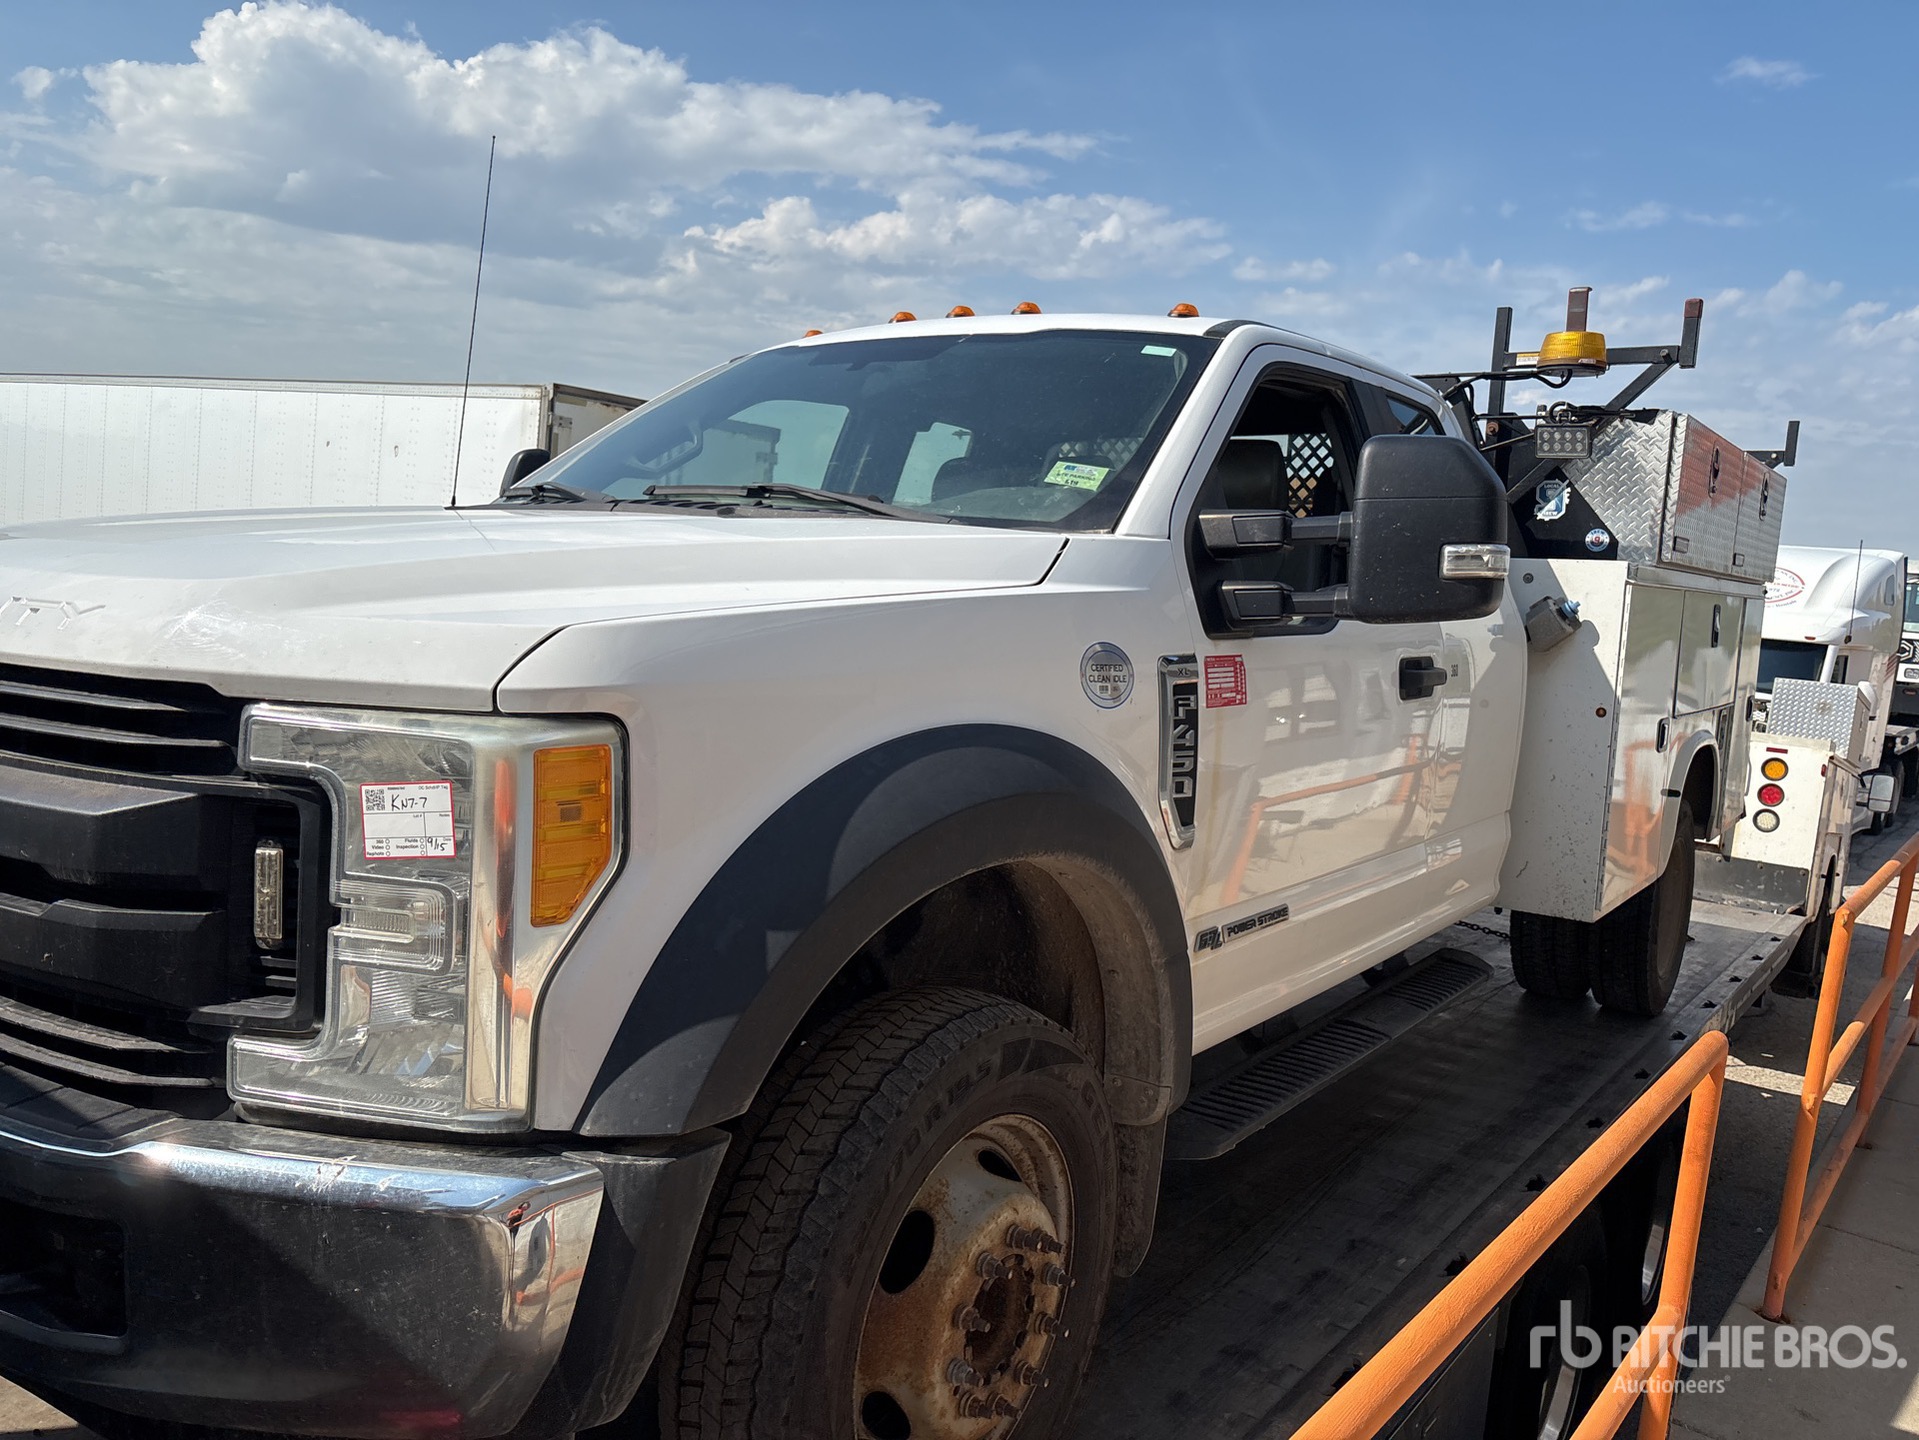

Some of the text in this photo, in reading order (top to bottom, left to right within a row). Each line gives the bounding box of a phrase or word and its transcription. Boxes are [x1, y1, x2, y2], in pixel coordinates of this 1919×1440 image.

[1090, 663, 1124, 672] CERTIFIED
[1177, 667, 1190, 676] XL
[1088, 674, 1127, 683] CLEAN IDLE
[1227, 917, 1257, 938] POWER
[1257, 906, 1289, 927] STROKE
